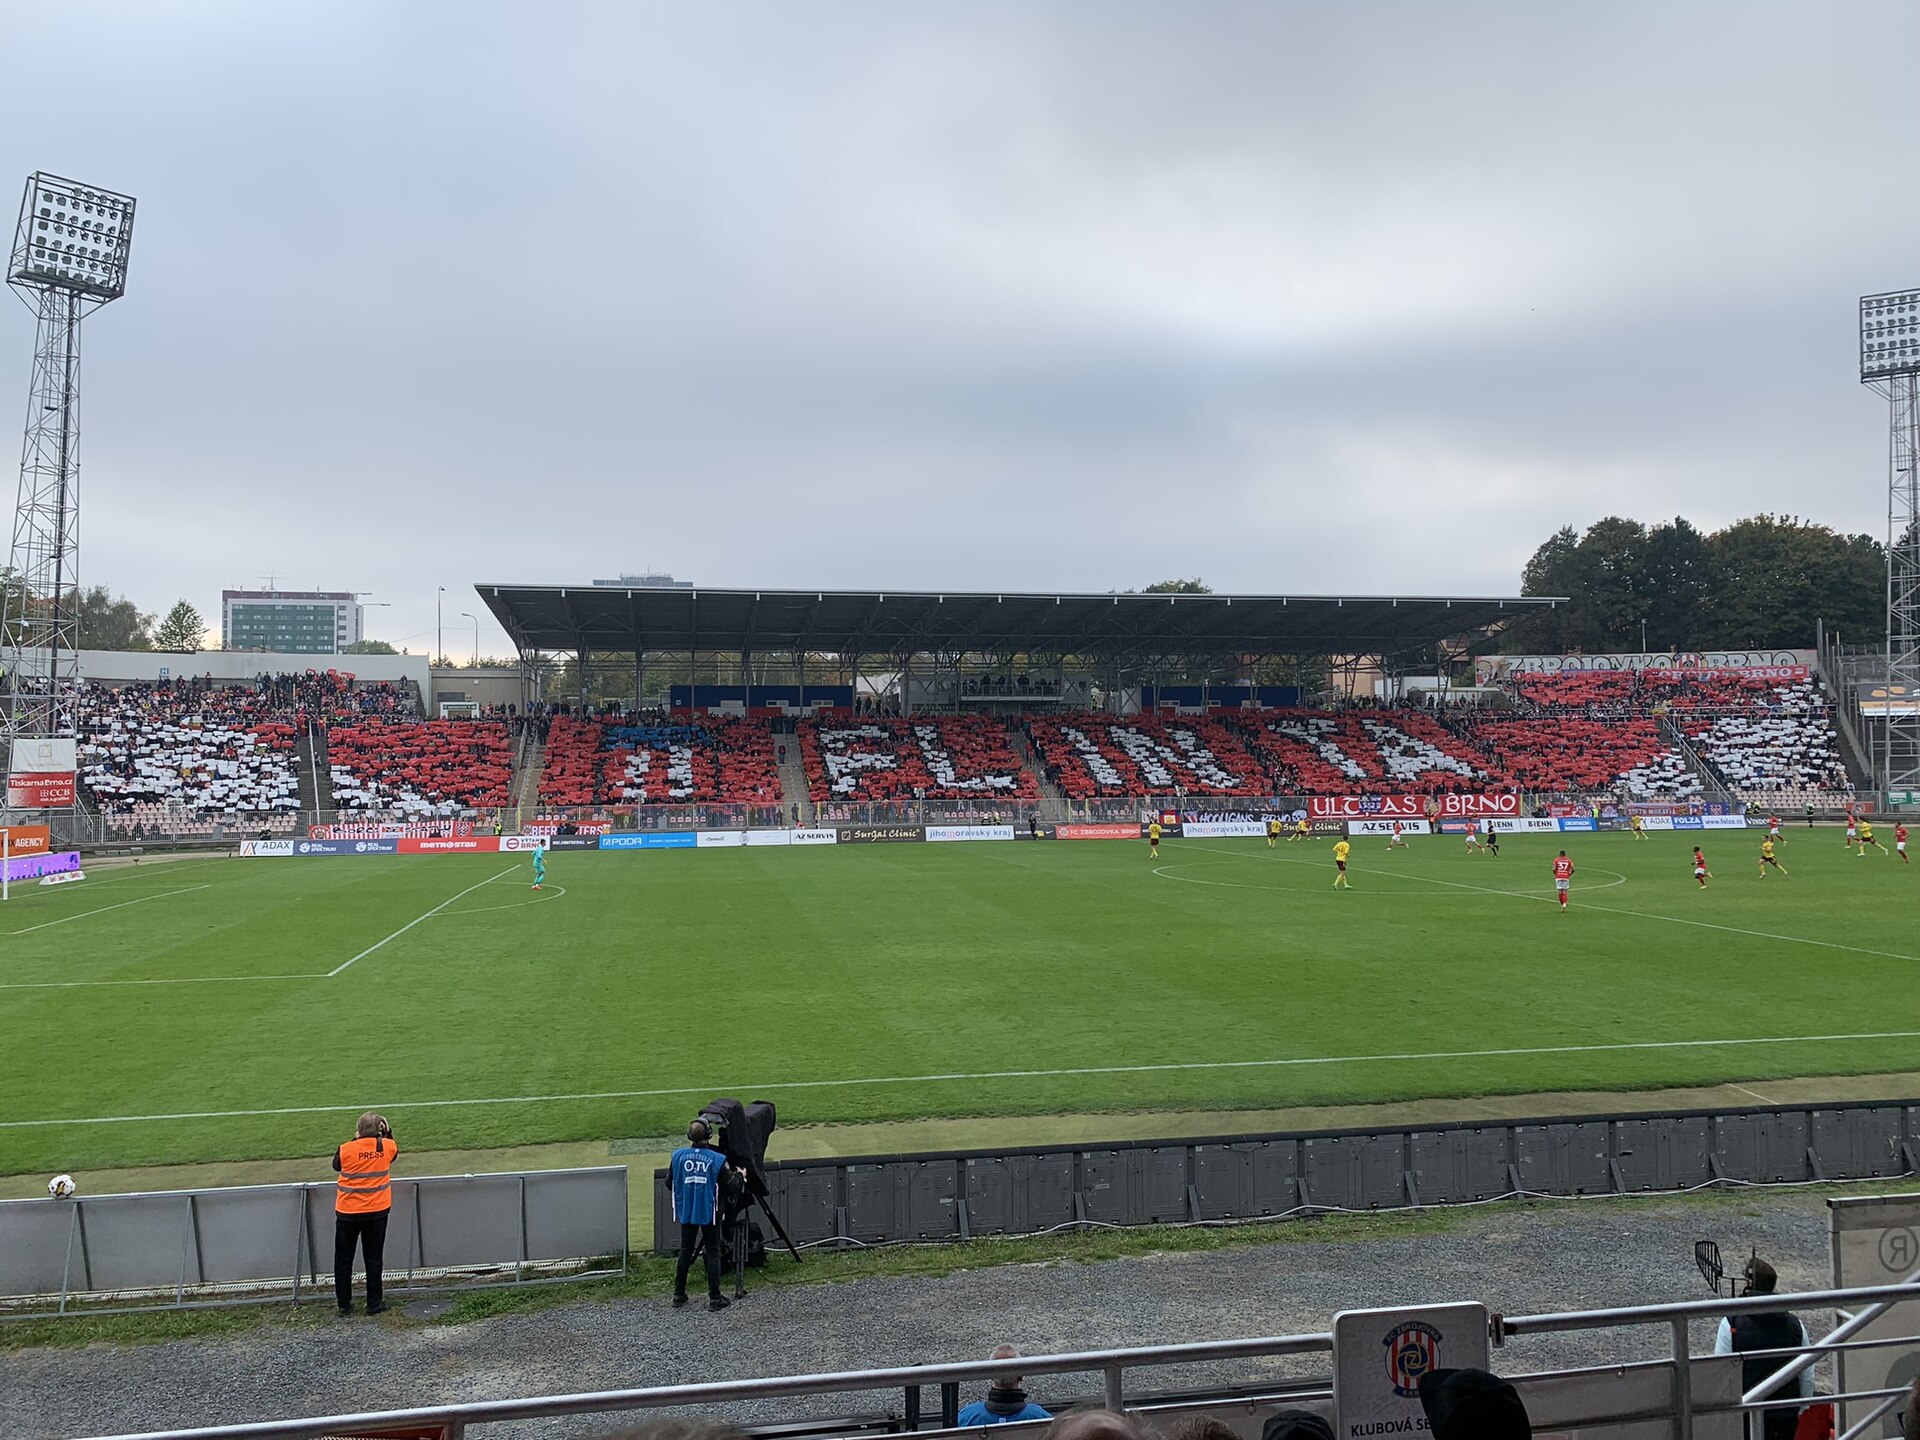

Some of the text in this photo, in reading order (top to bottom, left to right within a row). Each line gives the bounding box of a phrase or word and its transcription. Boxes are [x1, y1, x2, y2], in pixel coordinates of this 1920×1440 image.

[1313, 796, 1418, 815] ULTAS
[1446, 793, 1516, 815] BRNO
[1199, 811, 1254, 823] HOOLIGANS
[1650, 815, 1670, 825] ADAX
[1674, 816, 1701, 824] FOLZA
[1362, 822, 1377, 831] AZ
[1528, 820, 1553, 828] BRENN
[930, 828, 991, 840] jihomoravský
[993, 827, 1012, 838] kraj
[1186, 825, 1264, 836] jihomoravský kraj
[262, 841, 290, 850] ADAX
[611, 837, 642, 846] PODA
[1557, 861, 1569, 871] 37
[358, 1151, 385, 1160] PRESS
[1351, 1416, 1413, 1437] KLUBOVÁ
